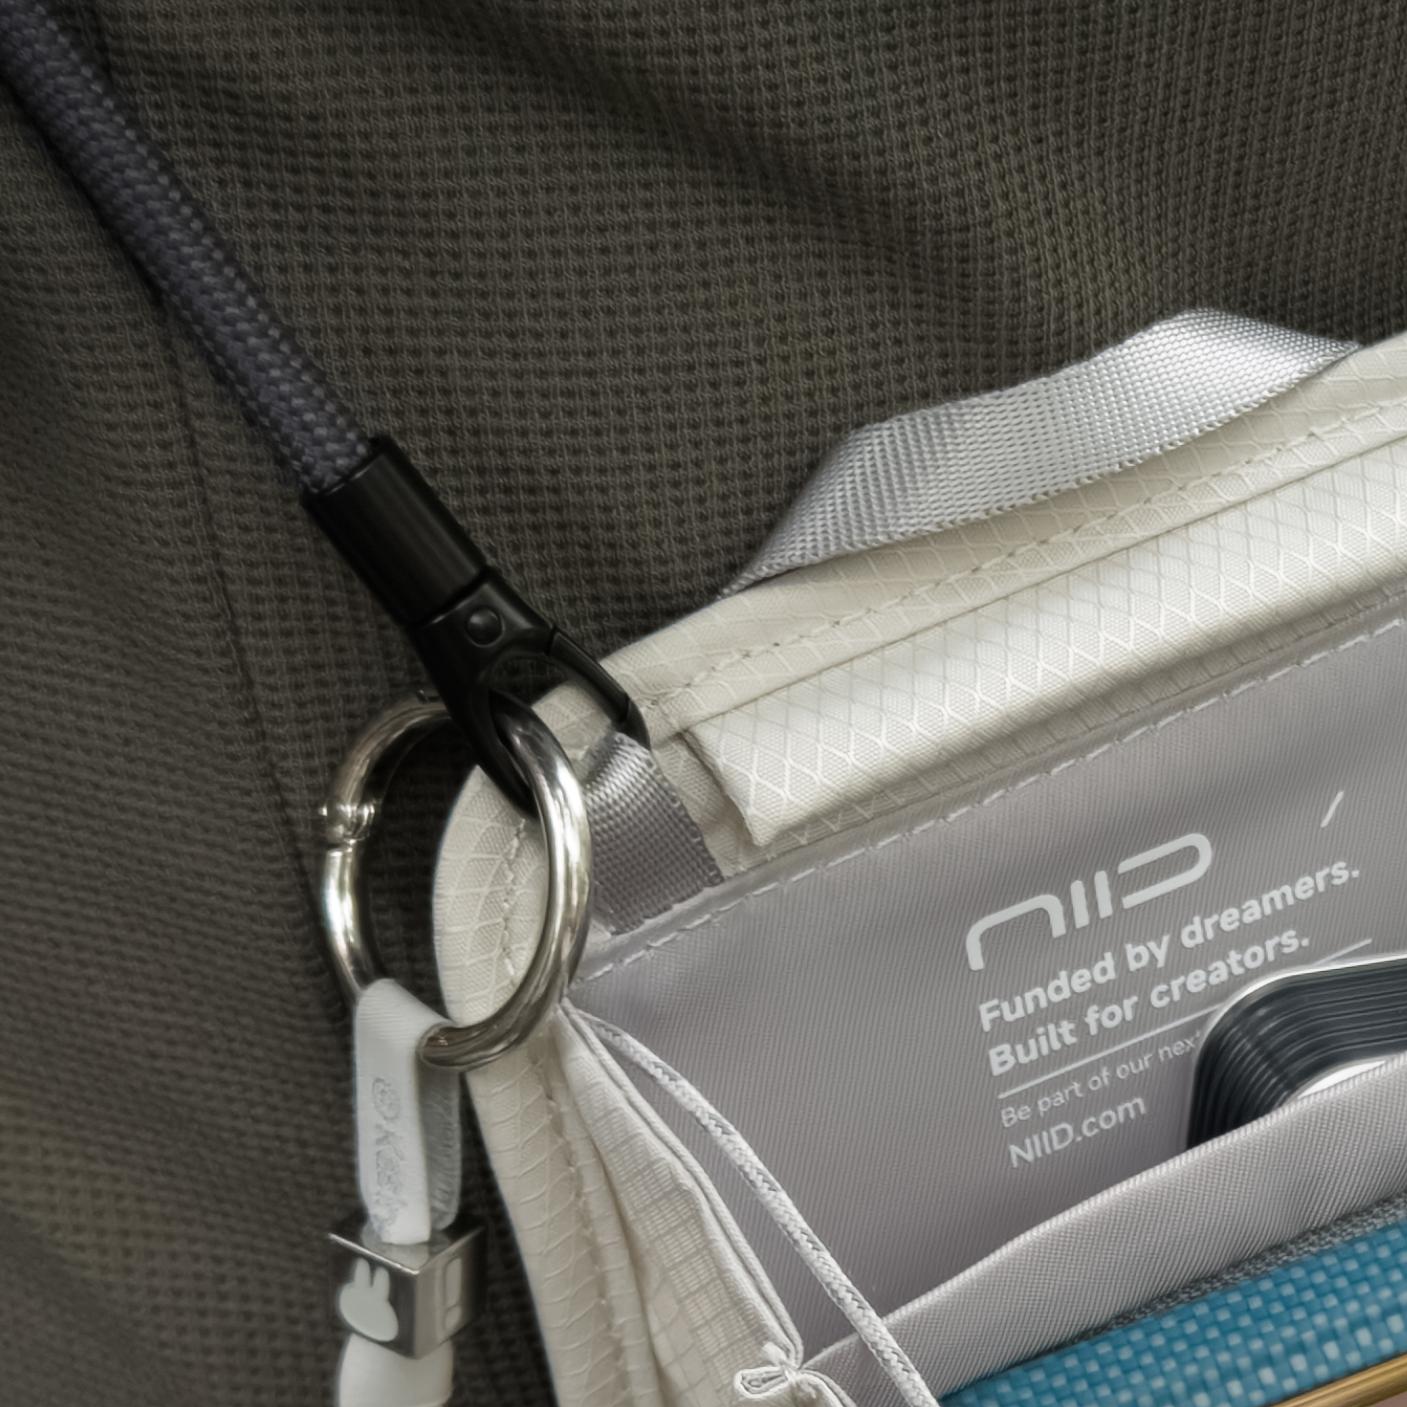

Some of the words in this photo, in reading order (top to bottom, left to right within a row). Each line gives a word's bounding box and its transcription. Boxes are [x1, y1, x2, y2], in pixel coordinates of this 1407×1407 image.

[978, 951, 1116, 1032] Funded
[1125, 935, 1170, 973] by
[1180, 860, 1360, 949] dreamers.
[988, 1021, 1078, 1076] Built
[1084, 996, 1139, 1036] for
[1150, 929, 1309, 1009] creators.
[1001, 1104, 1032, 1128] Be
[1038, 1081, 1084, 1117] part
[1088, 1066, 1110, 1090] of
[1116, 1054, 1153, 1079] our
[1158, 1030, 1200, 1062] nex
[1009, 1097, 1146, 1168] NIID.com
